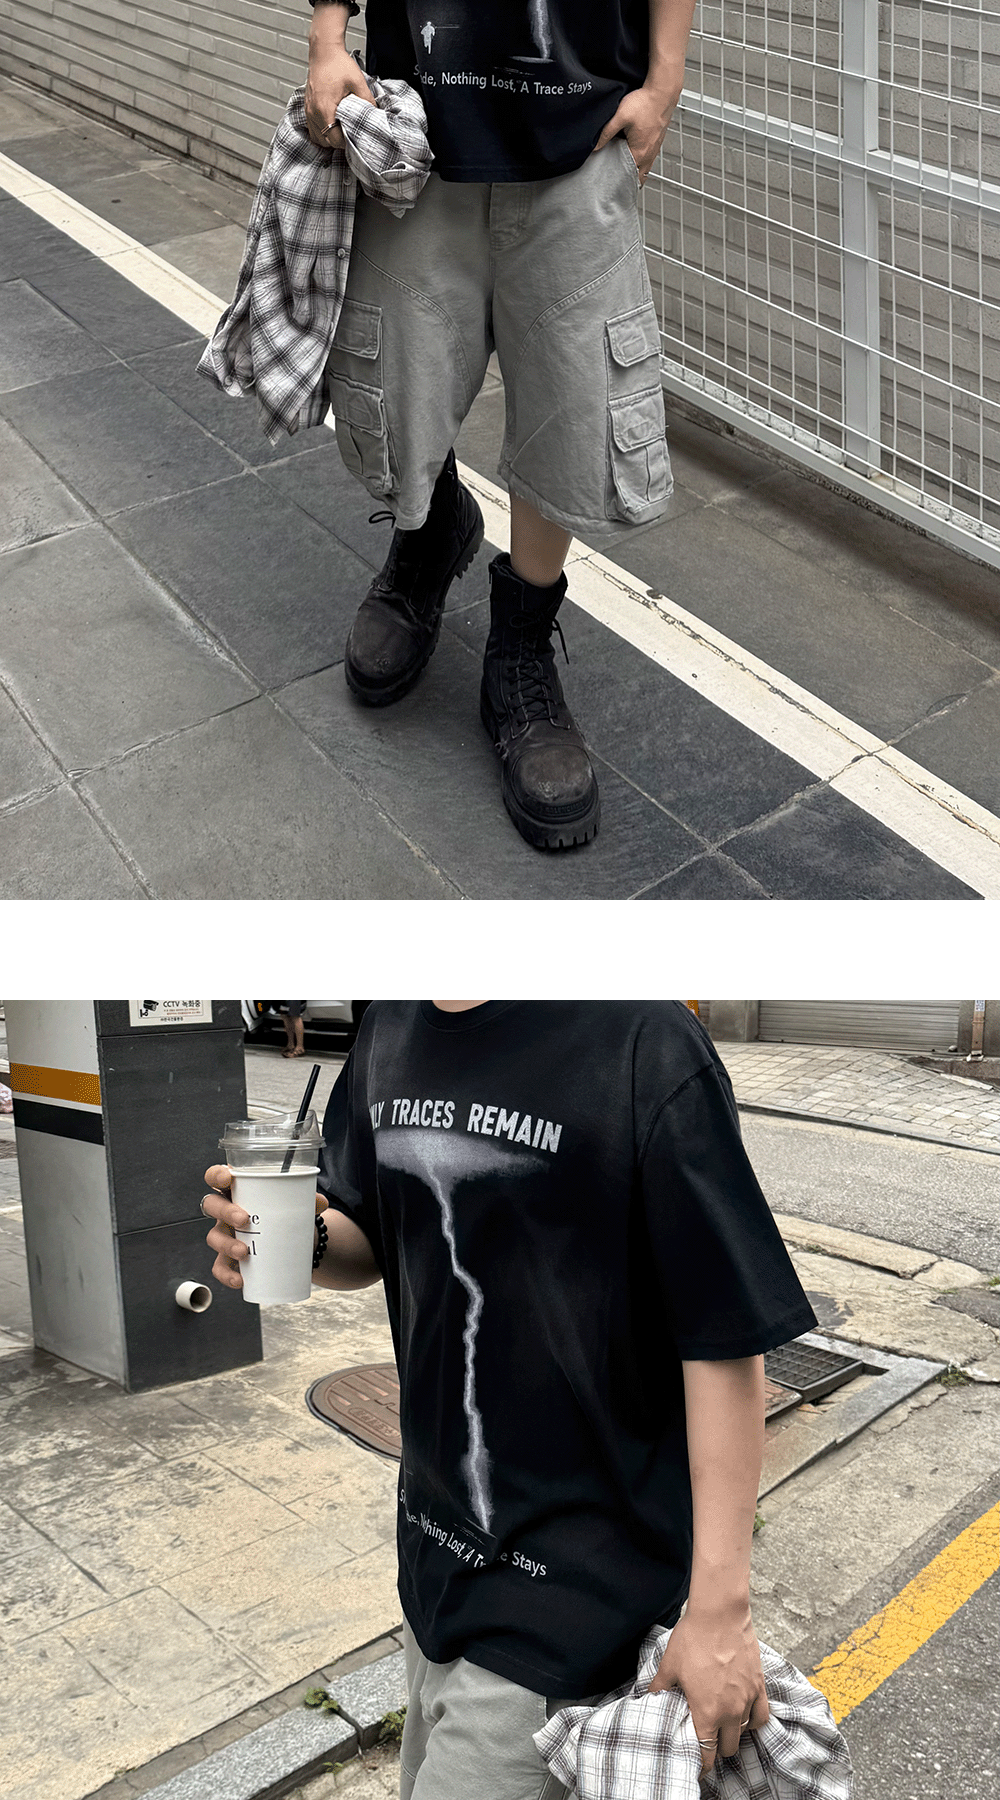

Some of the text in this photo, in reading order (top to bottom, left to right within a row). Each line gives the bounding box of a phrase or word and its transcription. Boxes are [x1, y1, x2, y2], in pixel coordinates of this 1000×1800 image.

[441, 71, 487, 89] Nothing
[491, 74, 517, 93] Lost,
[520, 81, 530, 94] A
[533, 81, 564, 95] Trace
[566, 81, 593, 95] Stays
[162, 1000, 180, 1008] CCTV
[391, 1098, 456, 1129] TRACES
[466, 1102, 563, 1153] REMAIN
[511, 1551, 548, 1577] Stays
